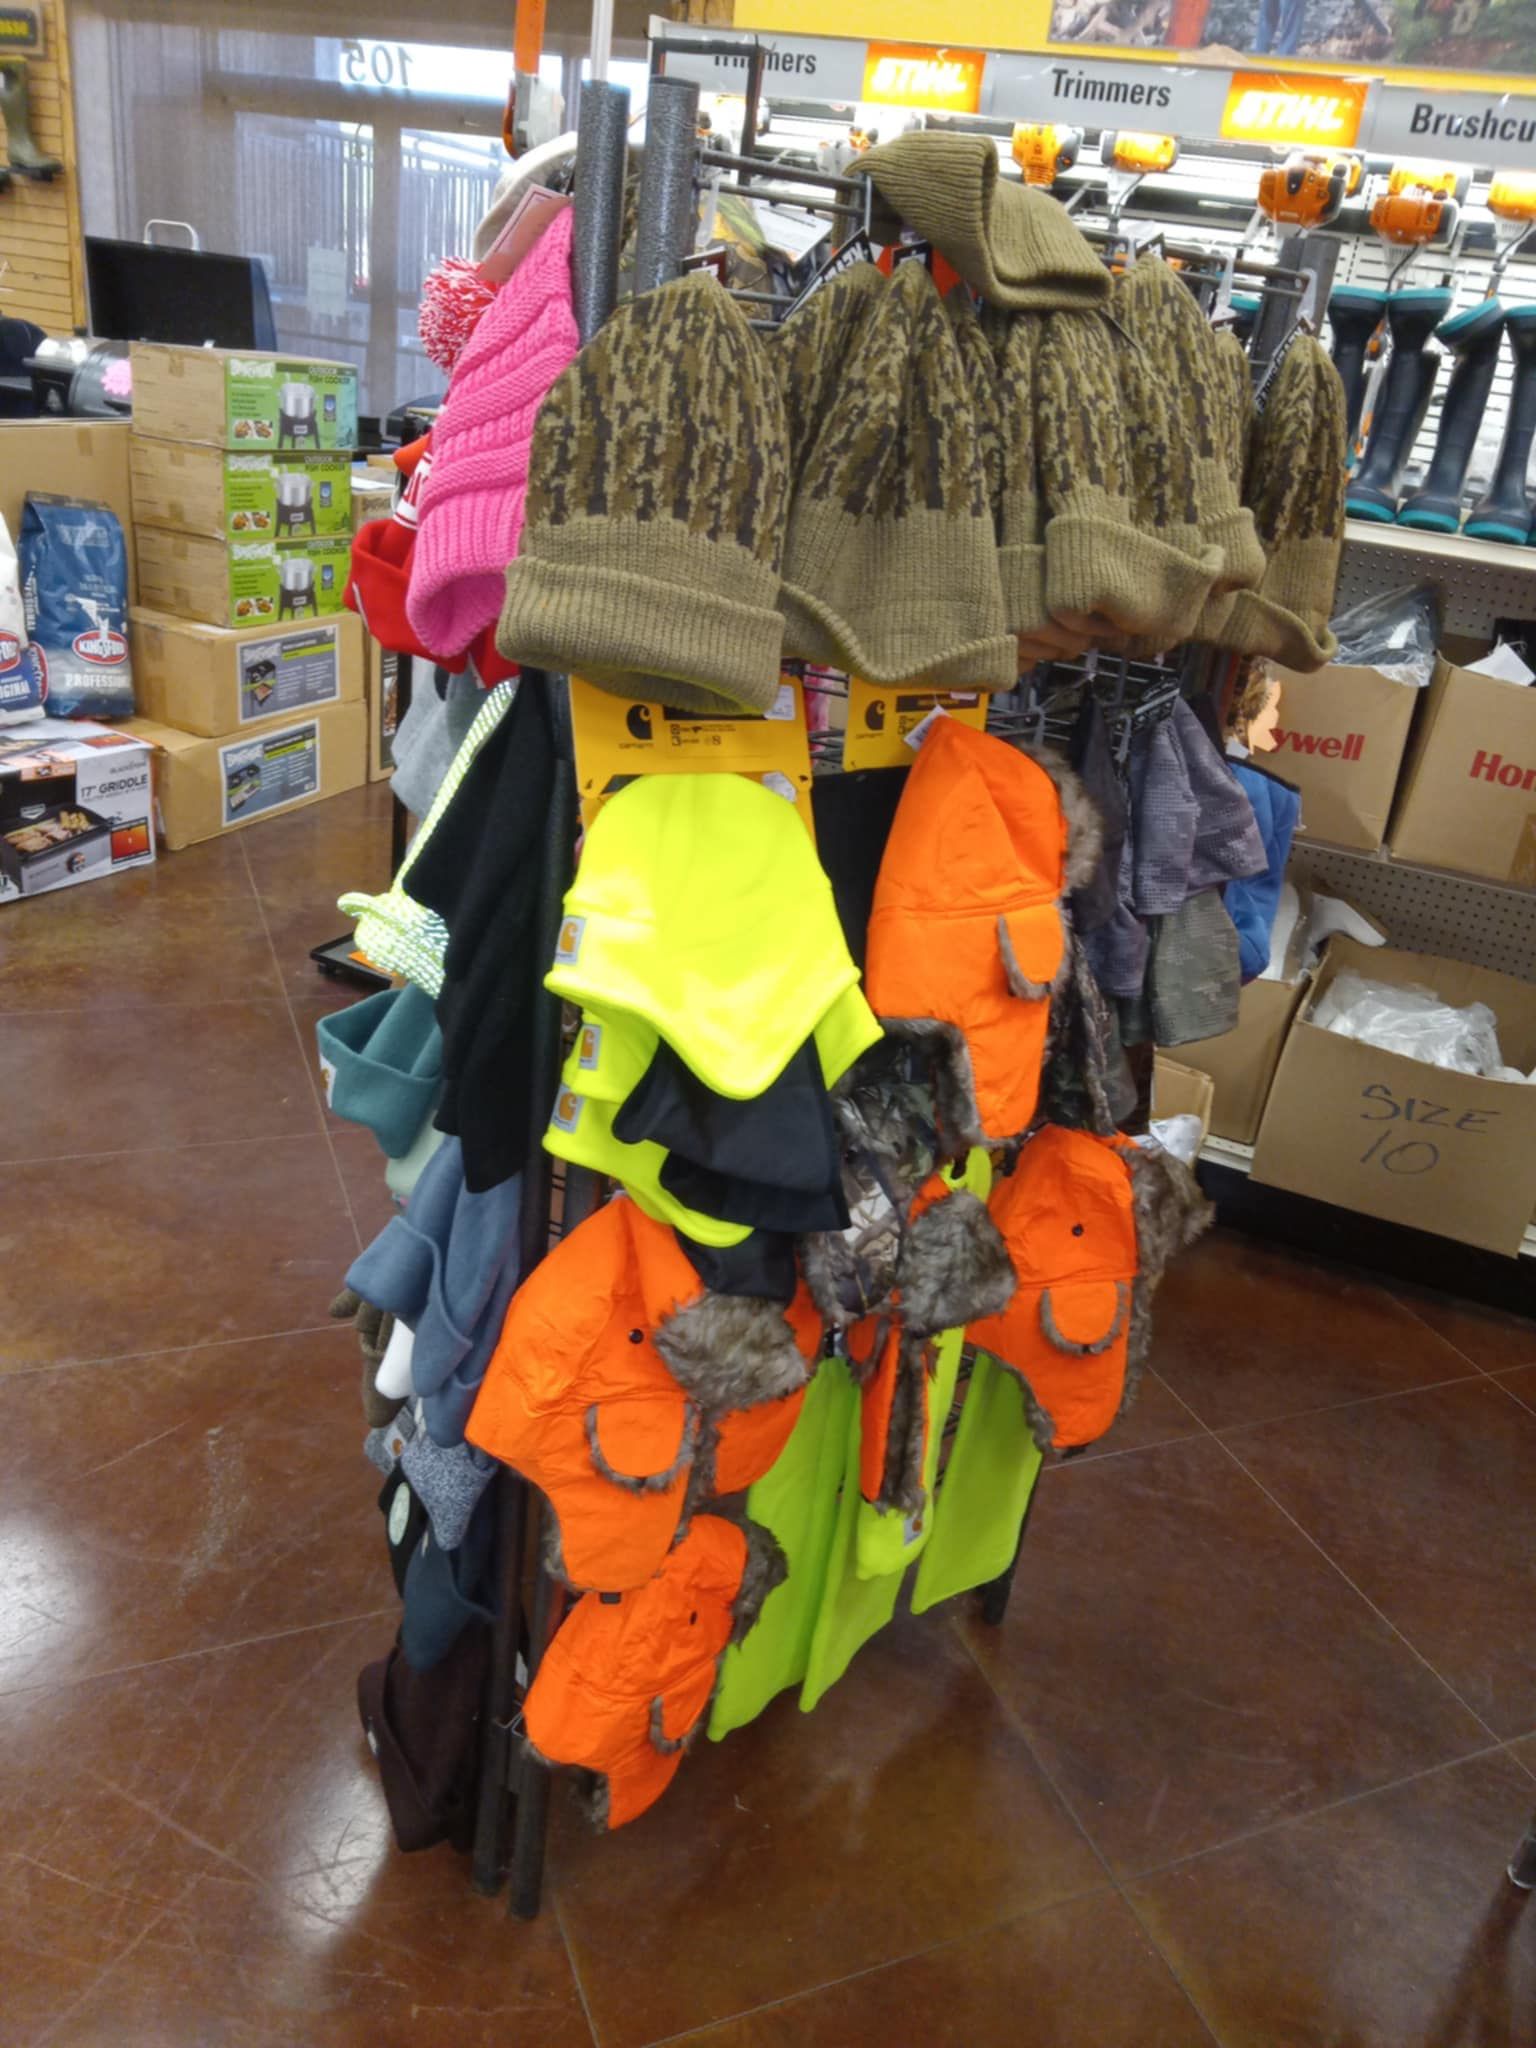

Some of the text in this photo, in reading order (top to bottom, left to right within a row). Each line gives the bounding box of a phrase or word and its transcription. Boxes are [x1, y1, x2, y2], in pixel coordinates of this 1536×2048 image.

[870, 56, 969, 95] STIHL
[1052, 68, 1171, 107] Trimmers
[1230, 91, 1345, 131] STIHL
[1410, 103, 1536, 143] Brushcu
[99, 774, 148, 794] GRIDDLE
[1361, 1084, 1502, 1133] SIZE
[1360, 1130, 1440, 1175] 10
